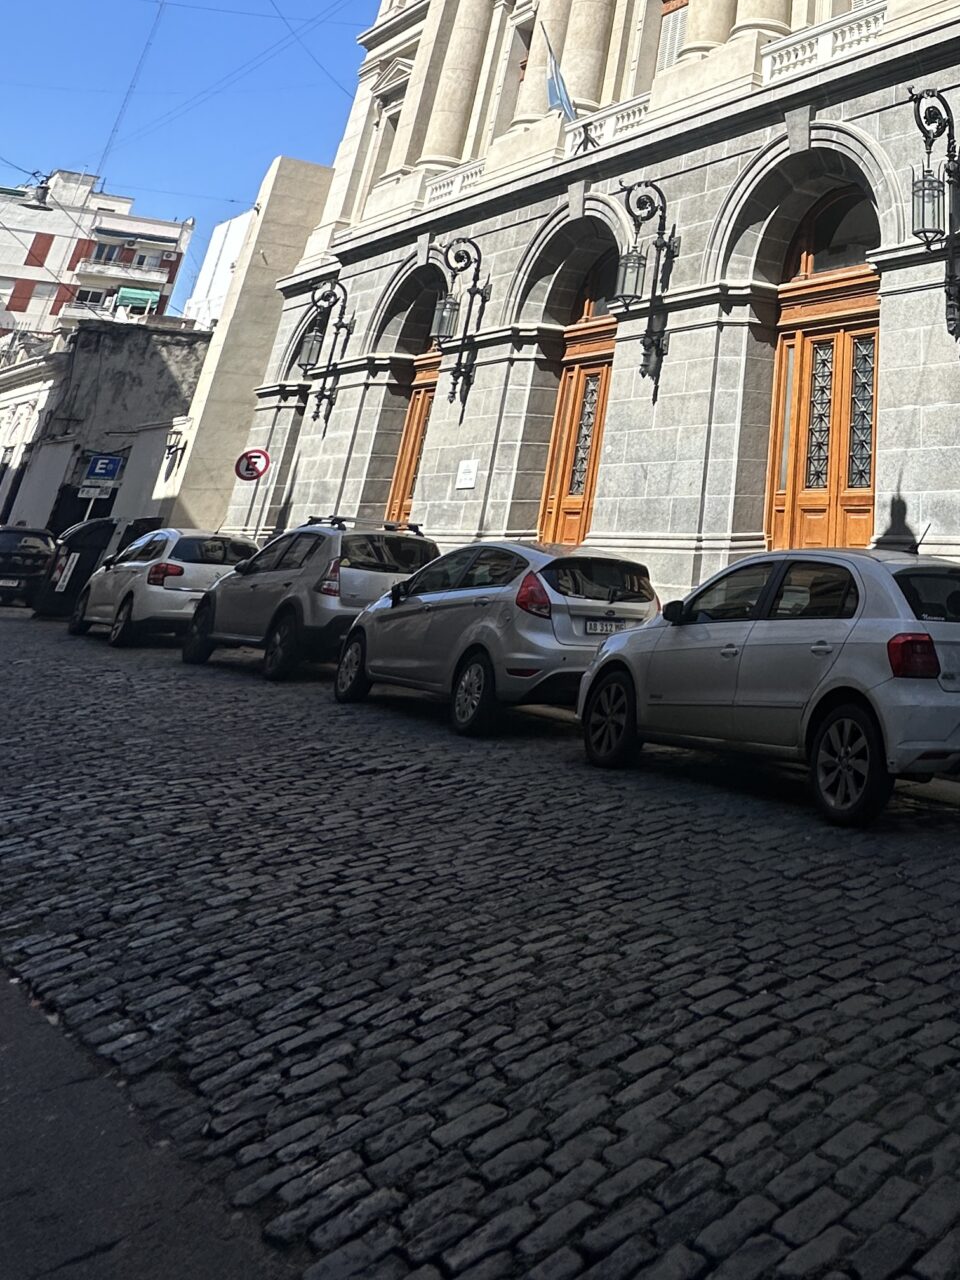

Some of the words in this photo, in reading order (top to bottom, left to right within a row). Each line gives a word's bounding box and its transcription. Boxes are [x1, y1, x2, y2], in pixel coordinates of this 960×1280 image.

[95, 460, 109, 473] E
[245, 455, 261, 471] E
[600, 622, 613, 633] 312
